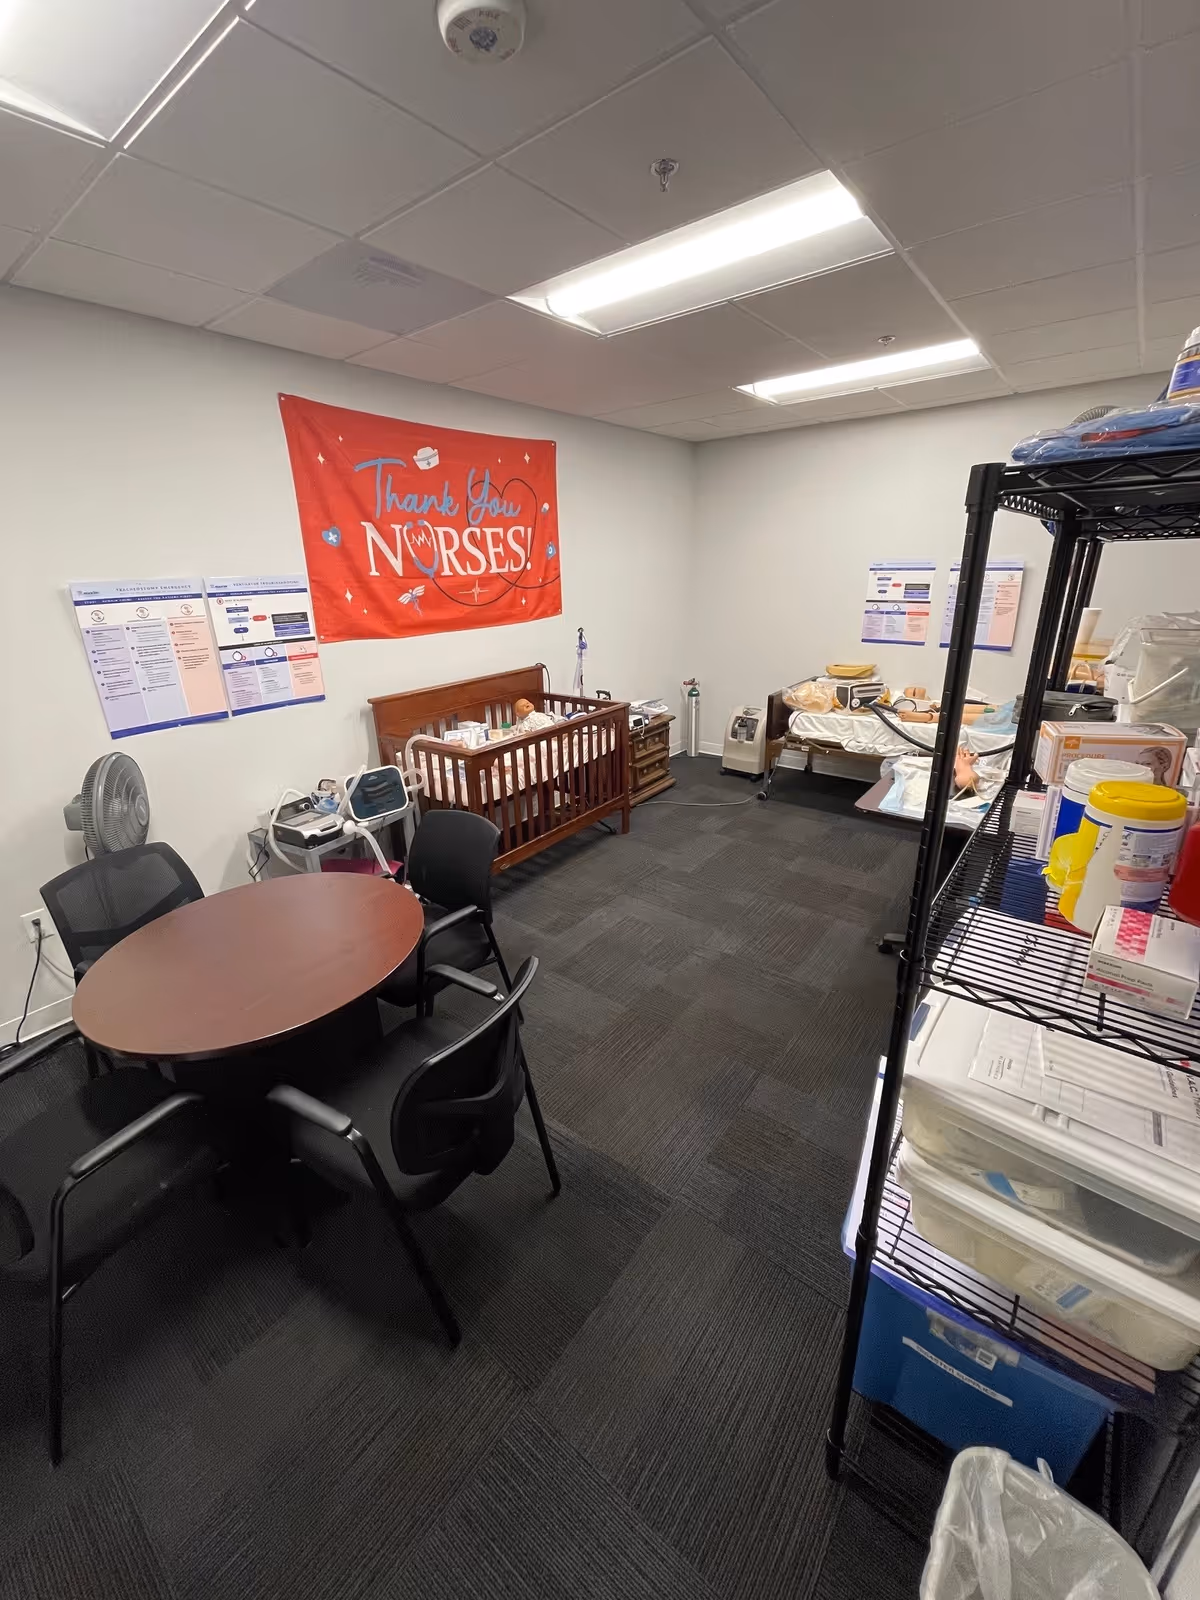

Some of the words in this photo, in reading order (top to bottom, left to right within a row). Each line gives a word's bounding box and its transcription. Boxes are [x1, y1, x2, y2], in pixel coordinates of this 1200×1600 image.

[353, 457, 459, 519] Thank
[466, 468, 521, 525] You
[360, 519, 533, 579] NURSES!
